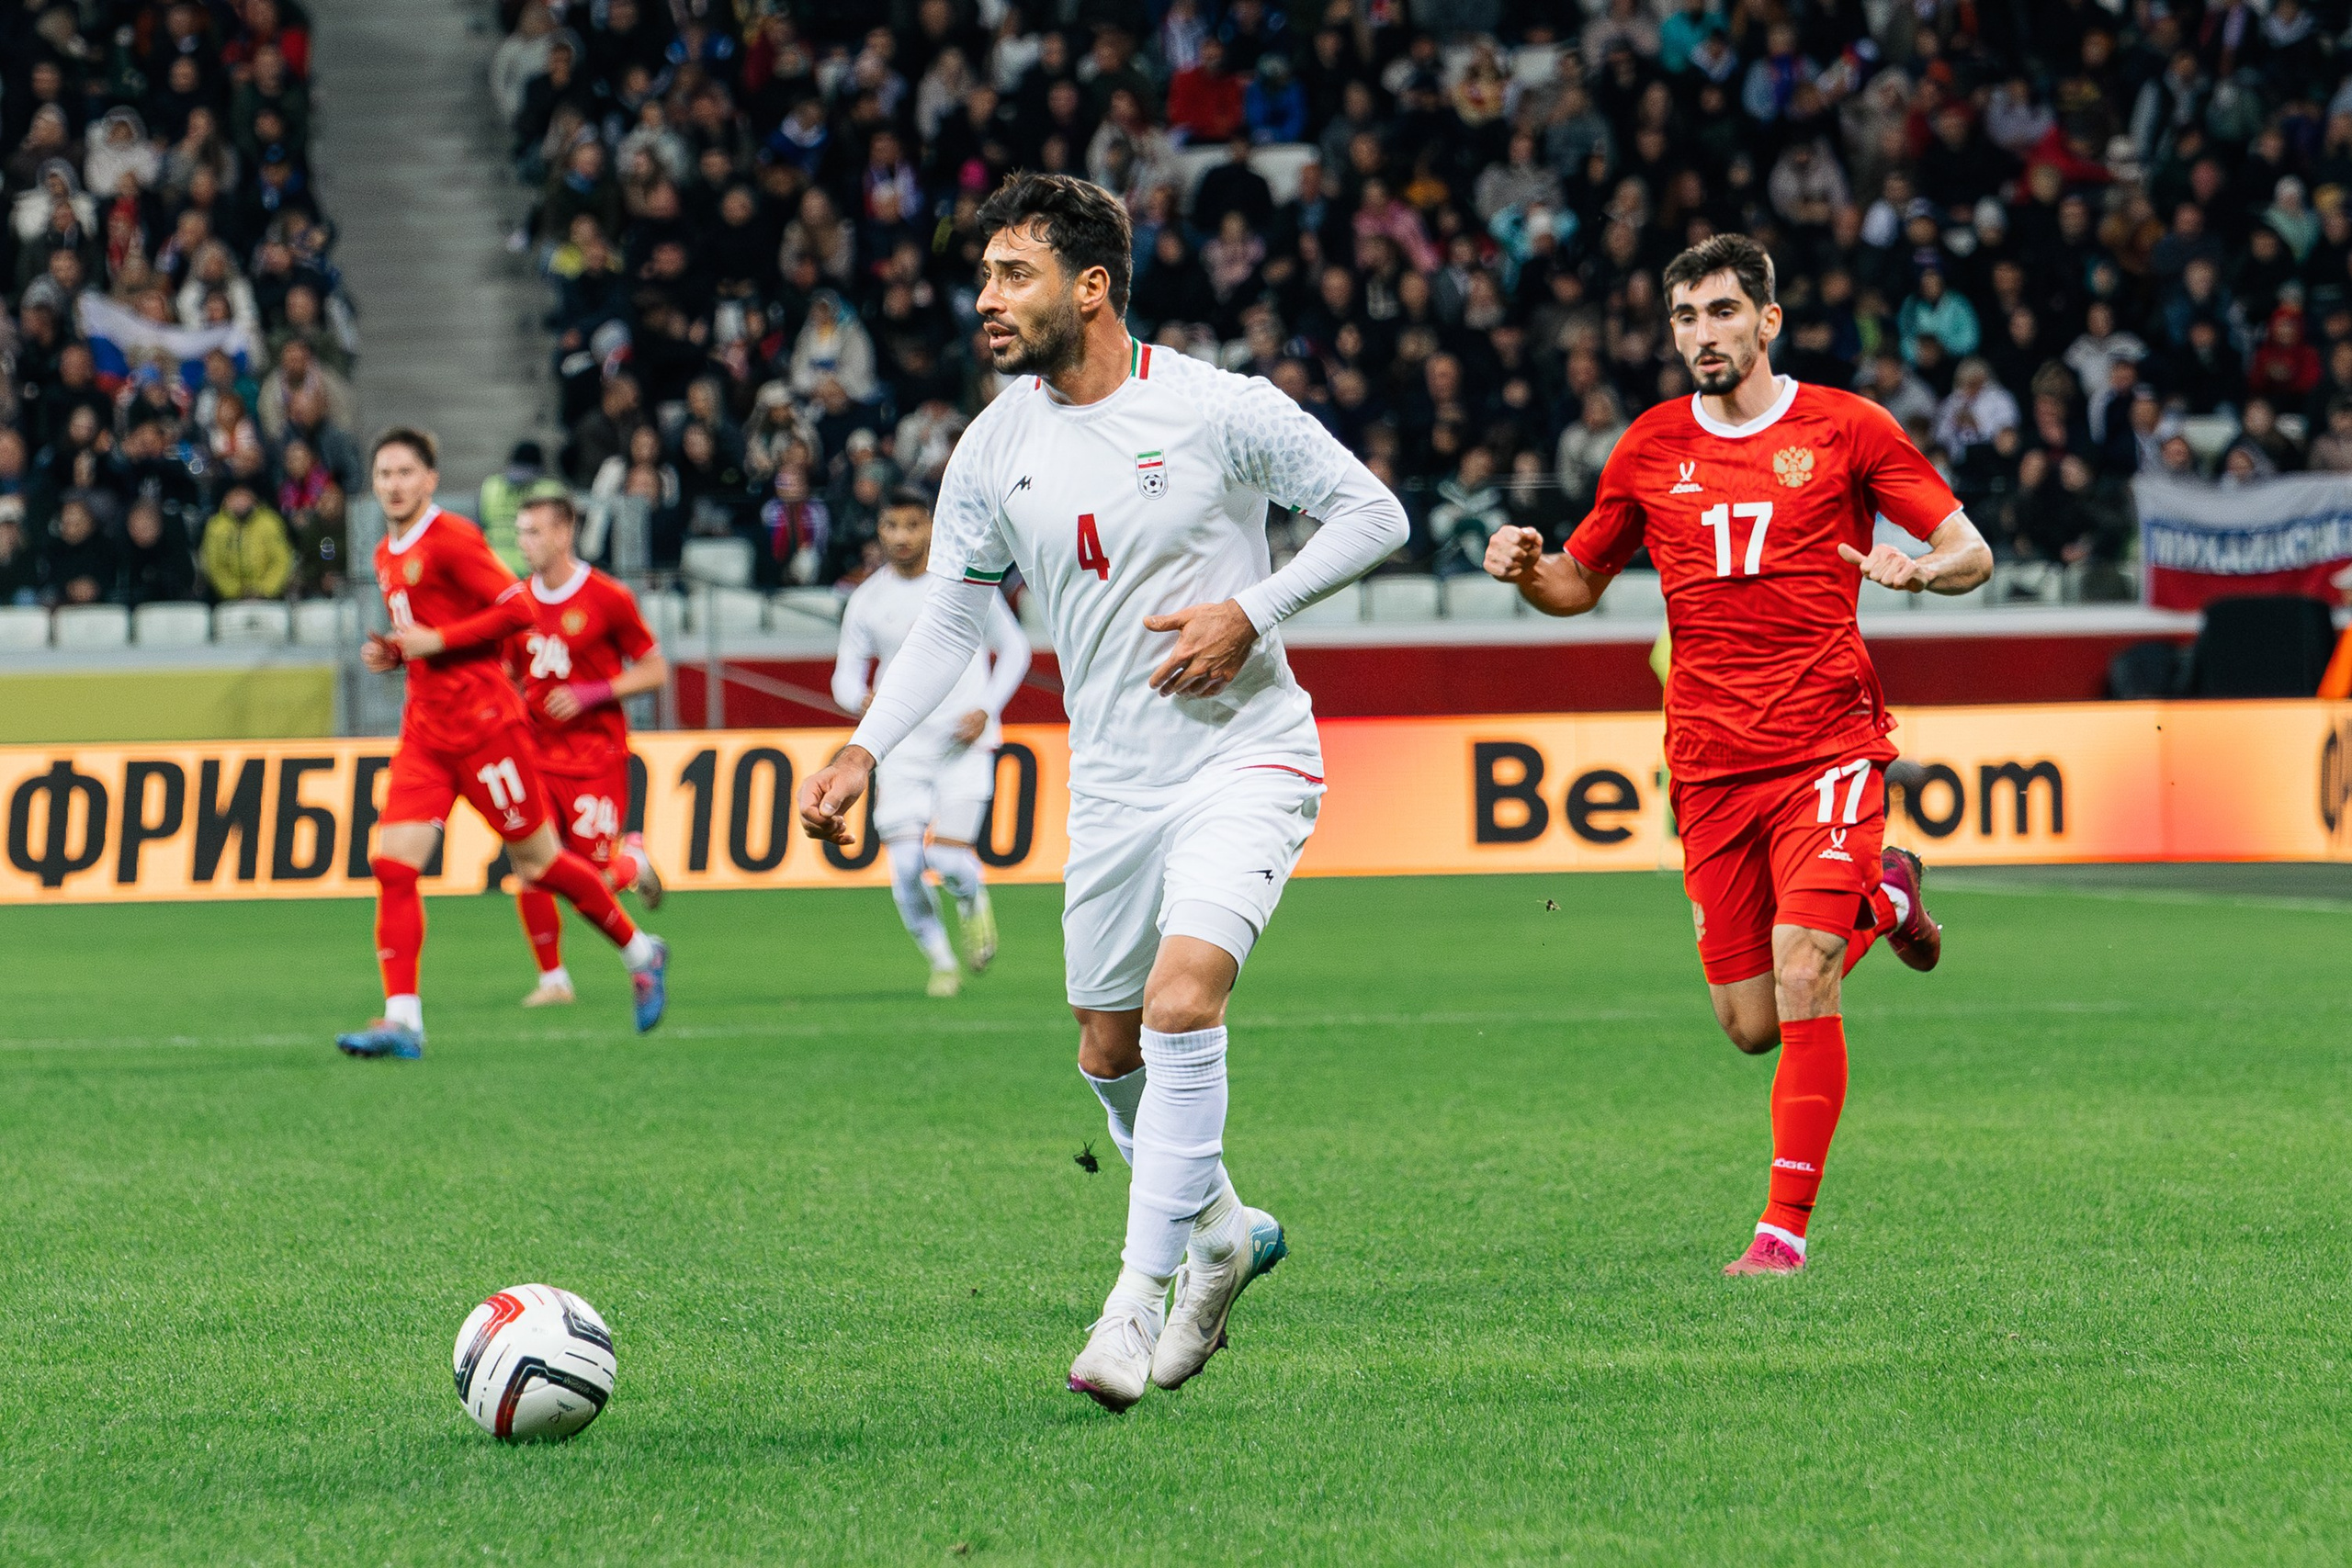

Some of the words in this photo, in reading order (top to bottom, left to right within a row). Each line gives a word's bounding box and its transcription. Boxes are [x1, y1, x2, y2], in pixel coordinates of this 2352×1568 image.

[1077, 513, 1111, 581] 4
[1701, 501, 1773, 577] 17
[526, 634, 572, 679] 24
[477, 757, 526, 809] 11
[679, 748, 794, 873] 10
[1815, 758, 1871, 824] 17
[571, 794, 619, 840] 24
